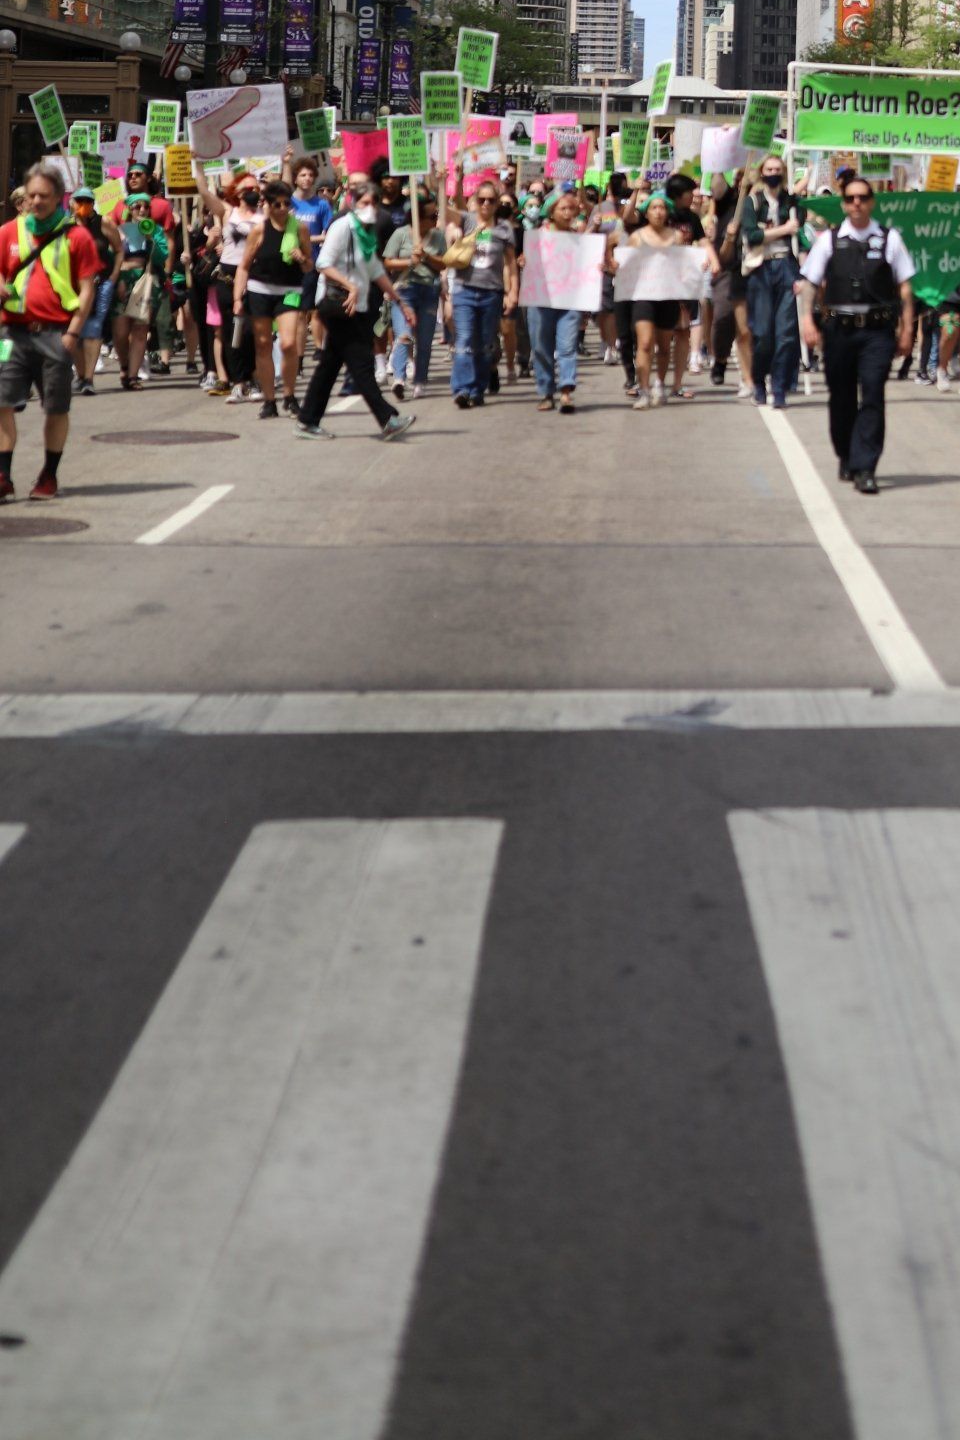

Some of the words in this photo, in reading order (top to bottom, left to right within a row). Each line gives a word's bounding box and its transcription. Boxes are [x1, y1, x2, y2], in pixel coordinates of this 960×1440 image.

[358, 6, 374, 39] OLD
[801, 85, 899, 115] Overturn
[853, 130, 880, 143] Rise
[883, 131, 899, 146] Up
[903, 132, 911, 143] 4
[880, 198, 918, 214] will
[914, 220, 951, 238] will
